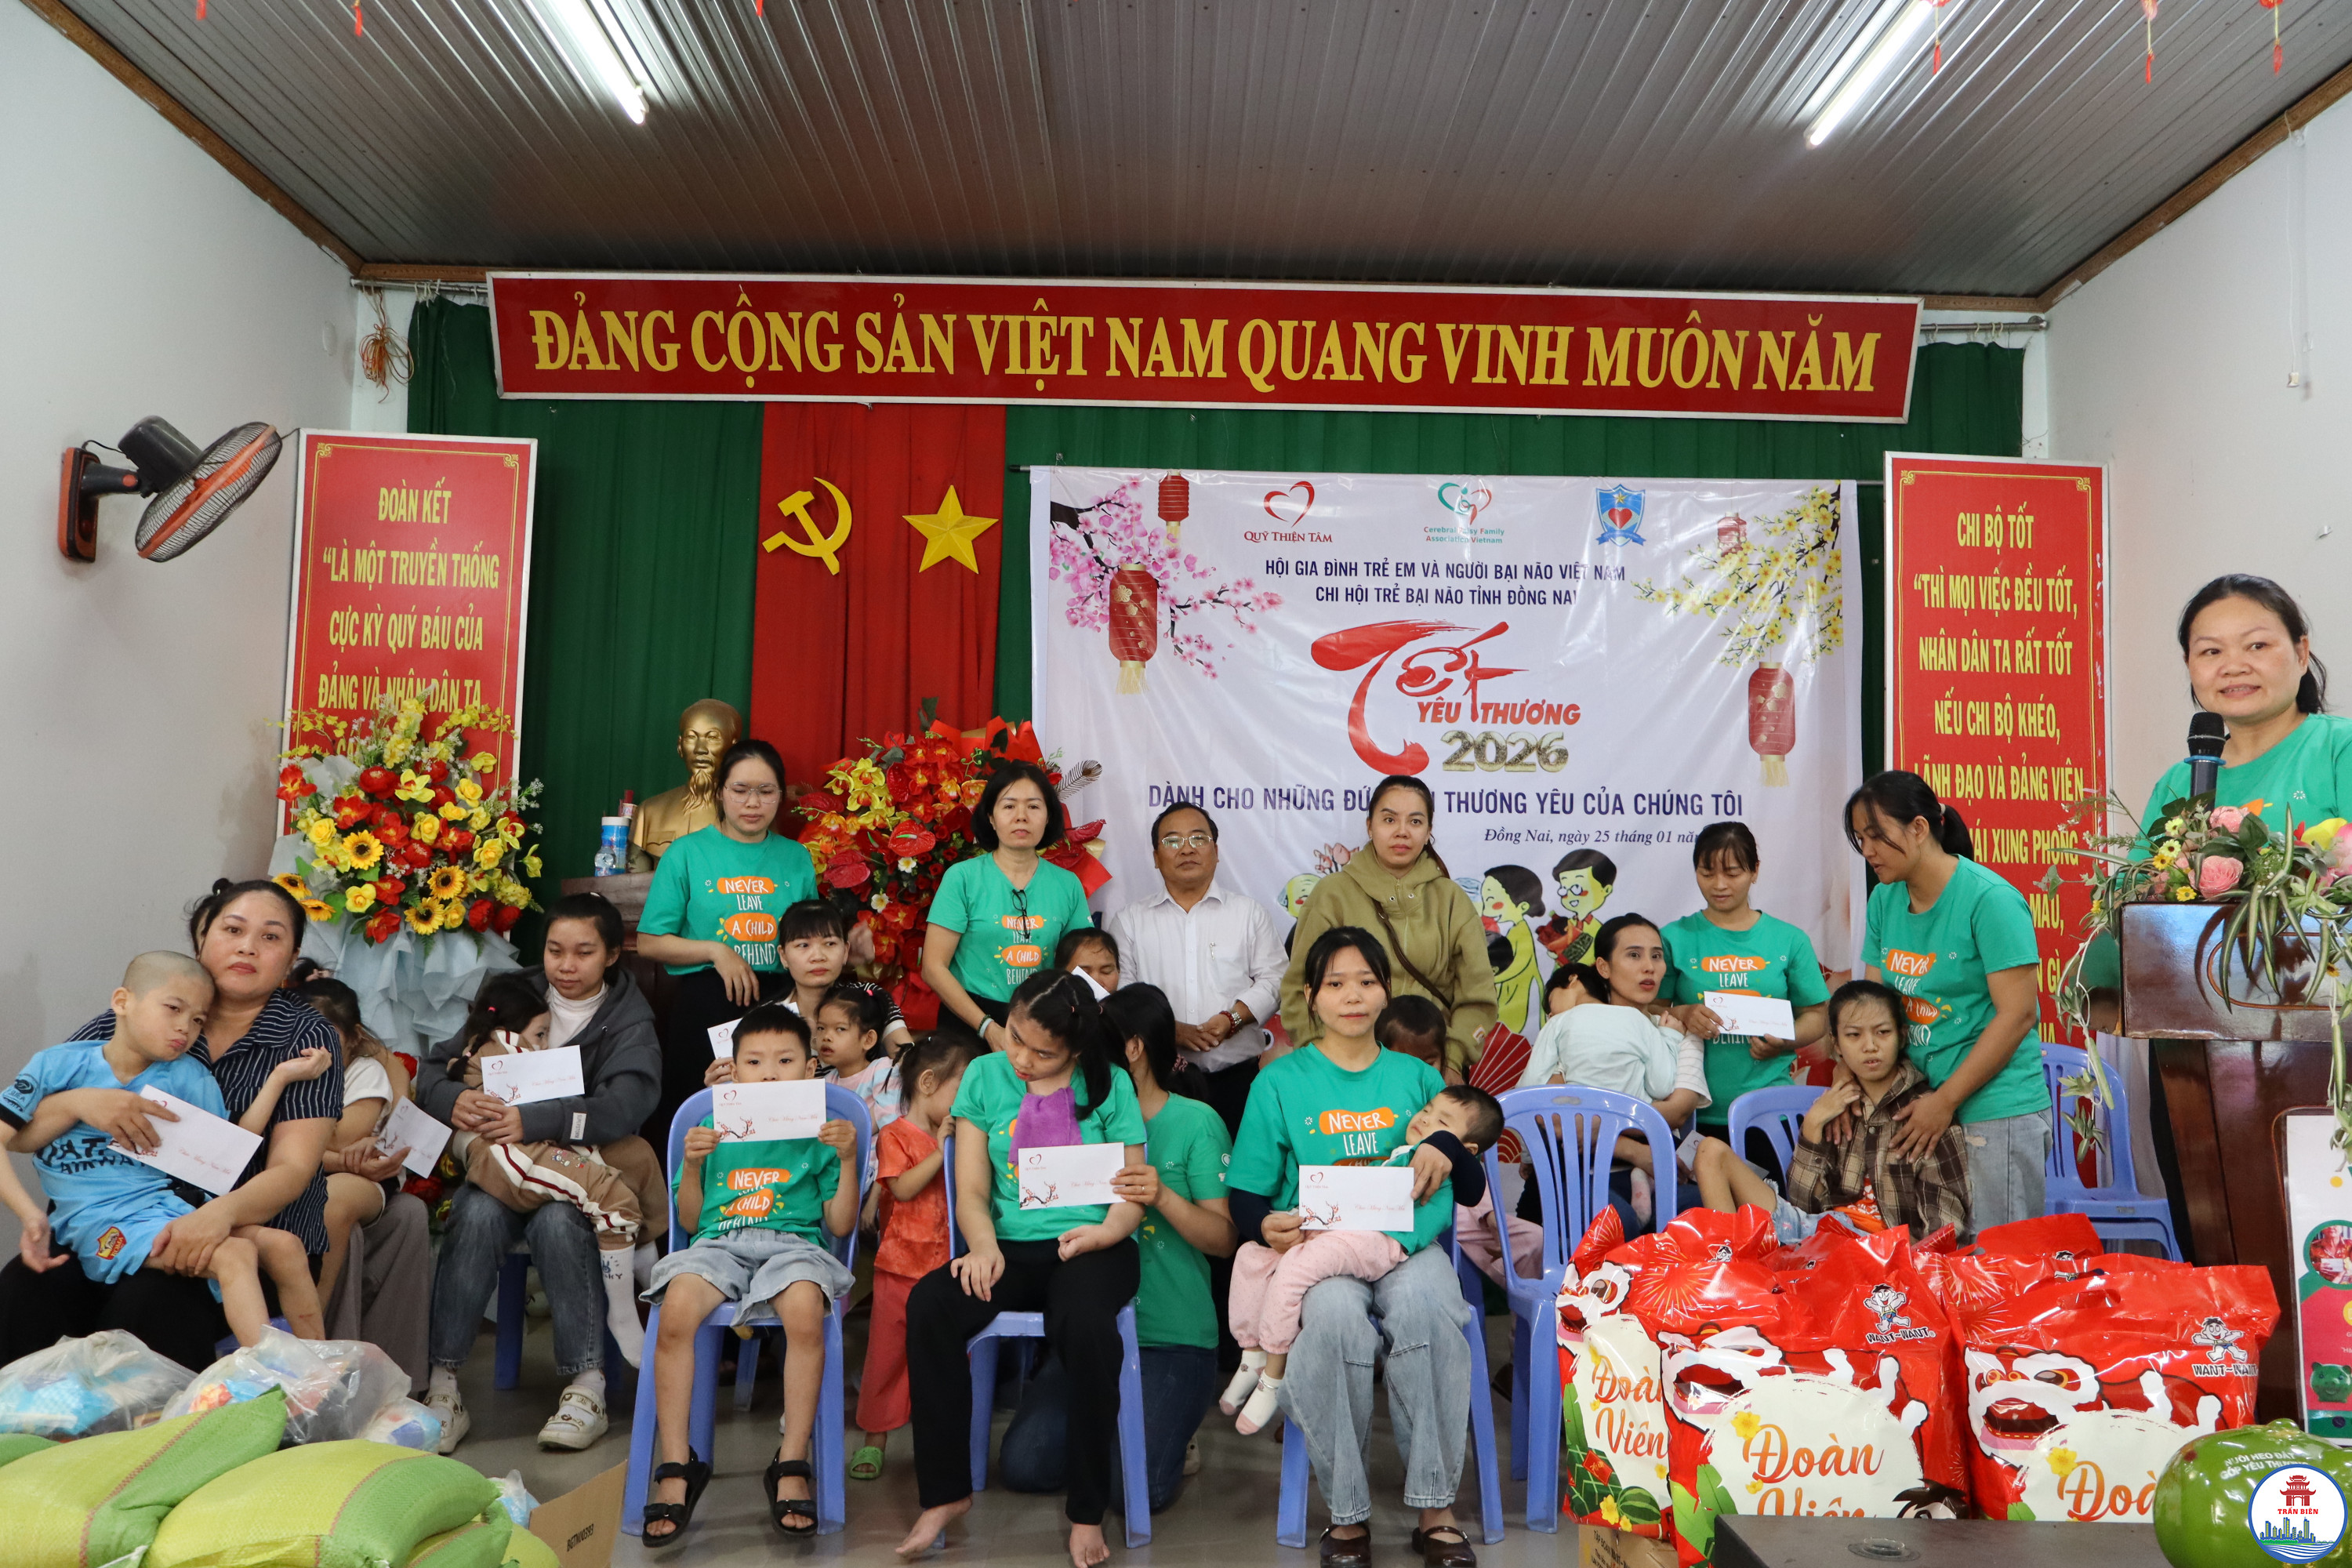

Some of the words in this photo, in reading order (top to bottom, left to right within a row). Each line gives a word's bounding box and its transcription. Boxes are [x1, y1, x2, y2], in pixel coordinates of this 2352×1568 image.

[529, 291, 681, 373] ĐẢNG
[690, 293, 844, 388] CỘNG
[855, 293, 957, 375] SẢN
[966, 298, 1094, 391] VIỆT
[1105, 317, 1229, 379] NAM
[1238, 318, 1428, 392] QUANG
[1436, 323, 1575, 387] VINH
[1582, 310, 1750, 390] MUÔN
[1751, 313, 1882, 392] NĂM
[378, 479, 419, 522] ĐOÀN
[422, 477, 452, 524] KẾT
[1244, 530, 1269, 543] QUỸ
[1271, 531, 1305, 543] THIỆN
[1307, 532, 1333, 543] TÂM
[1479, 528, 1504, 536] Family
[1957, 512, 1980, 547] CHI
[1984, 504, 2003, 555] BỘ
[2007, 501, 2034, 549] TỐT
[354, 540, 386, 590] MỘT
[390, 537, 446, 586] TRUYỀN
[452, 541, 499, 589] THỐNG
[1265, 557, 1289, 577] HỘI
[1294, 561, 1319, 576] GIA
[1323, 557, 1358, 578] ĐÌNH
[1363, 557, 1390, 578] TRẺ
[1395, 563, 1415, 578] EM
[1421, 558, 1440, 579] VÀ
[1445, 558, 1488, 579] NGƯỜI
[1494, 564, 1518, 582] BẠI
[1523, 560, 1553, 580] NÃO
[1559, 561, 1589, 583] VIỆT
[1594, 565, 1625, 581] NAM
[1316, 586, 1341, 603] CHI
[1345, 584, 1369, 604] HỘI
[1374, 583, 1399, 603] TRẺ
[1405, 588, 1428, 606] BẠI
[1435, 583, 1464, 604] NÃO
[1468, 583, 1501, 605] TỈNH
[1507, 580, 1548, 606] ĐỒNG
[1949, 575, 1976, 616] MỌI
[1978, 567, 2011, 617] VIỆC
[2013, 562, 2042, 612] ĐỀU
[2046, 564, 2078, 620] TỐT,
[329, 605, 359, 652] CỰC
[362, 603, 383, 647] KỲ
[387, 605, 417, 653] QUÝ
[420, 606, 450, 649] BÁU
[455, 603, 483, 651] CỦA
[1918, 627, 1957, 671] NHÂN
[1961, 629, 1990, 673] DÂN
[1993, 639, 2012, 673] TA
[2015, 626, 2042, 674] RẤT
[2046, 627, 2073, 675] TỐT
[318, 661, 358, 710] ĐẢNG
[362, 666, 380, 710] VÀ
[387, 668, 426, 708] NHÂN
[430, 669, 459, 713] DÂN
[464, 679, 481, 710] TA
[1417, 695, 1461, 724] YÊU
[1478, 702, 1581, 726] THƯƠNG
[1934, 687, 1962, 735] NẾU
[1966, 701, 1990, 735] CHI
[1994, 693, 2013, 743] BỘ
[2018, 694, 2061, 745] KHÉO,
[1440, 730, 1570, 773] 2026
[1955, 764, 1984, 806] ĐẠO
[1987, 755, 2006, 800] VÀ
[2009, 752, 2049, 801] ĐẢNG
[2051, 758, 2084, 802] VIÊN
[1149, 781, 1204, 808] DÀNH
[1214, 786, 1254, 809] CHO
[1263, 783, 1334, 811] NHỮNG
[1344, 786, 1371, 811] ĐỨ
[1444, 789, 1530, 815] THƯƠNG
[1535, 786, 1575, 815] YÊU
[1582, 784, 1627, 816] CỦA
[1633, 786, 1704, 818] CHÚNG
[1708, 786, 1743, 817] TÔI
[1484, 826, 1521, 844] Đồng
[1525, 829, 1553, 844] Nai,
[1558, 829, 1589, 845] ngày
[1594, 830, 1610, 843] 25
[1615, 829, 1653, 846] tháng
[1656, 831, 1671, 843] 01
[1969, 818, 1991, 864] ÁI
[1992, 829, 2029, 864] XUNG
[2033, 830, 2079, 866] PHONG
[725, 878, 768, 894] NEVER
[736, 895, 764, 911] LEAVE
[731, 921, 742, 935] A
[746, 920, 774, 935] CHILD
[1007, 917, 1038, 931] NEVER
[1006, 949, 1014, 962] A
[1016, 950, 1040, 964] CHILD
[1709, 957, 1758, 972] NEVER
[1719, 973, 1748, 988] LEAVE
[1894, 975, 1921, 996] LEAVE
[1328, 1112, 1386, 1134] NEVER
[1342, 1132, 1378, 1156] LEAVE
[734, 1171, 780, 1191] NEVER
[737, 1195, 771, 1212] CHILD
[1595, 1407, 1668, 1458] Viên
[1742, 1424, 1884, 1483] Đoàn
[2242, 1461, 2265, 1472] YÊU
[2250, 1452, 2274, 1461] HEO
[2058, 1461, 2156, 1521] Đoà
